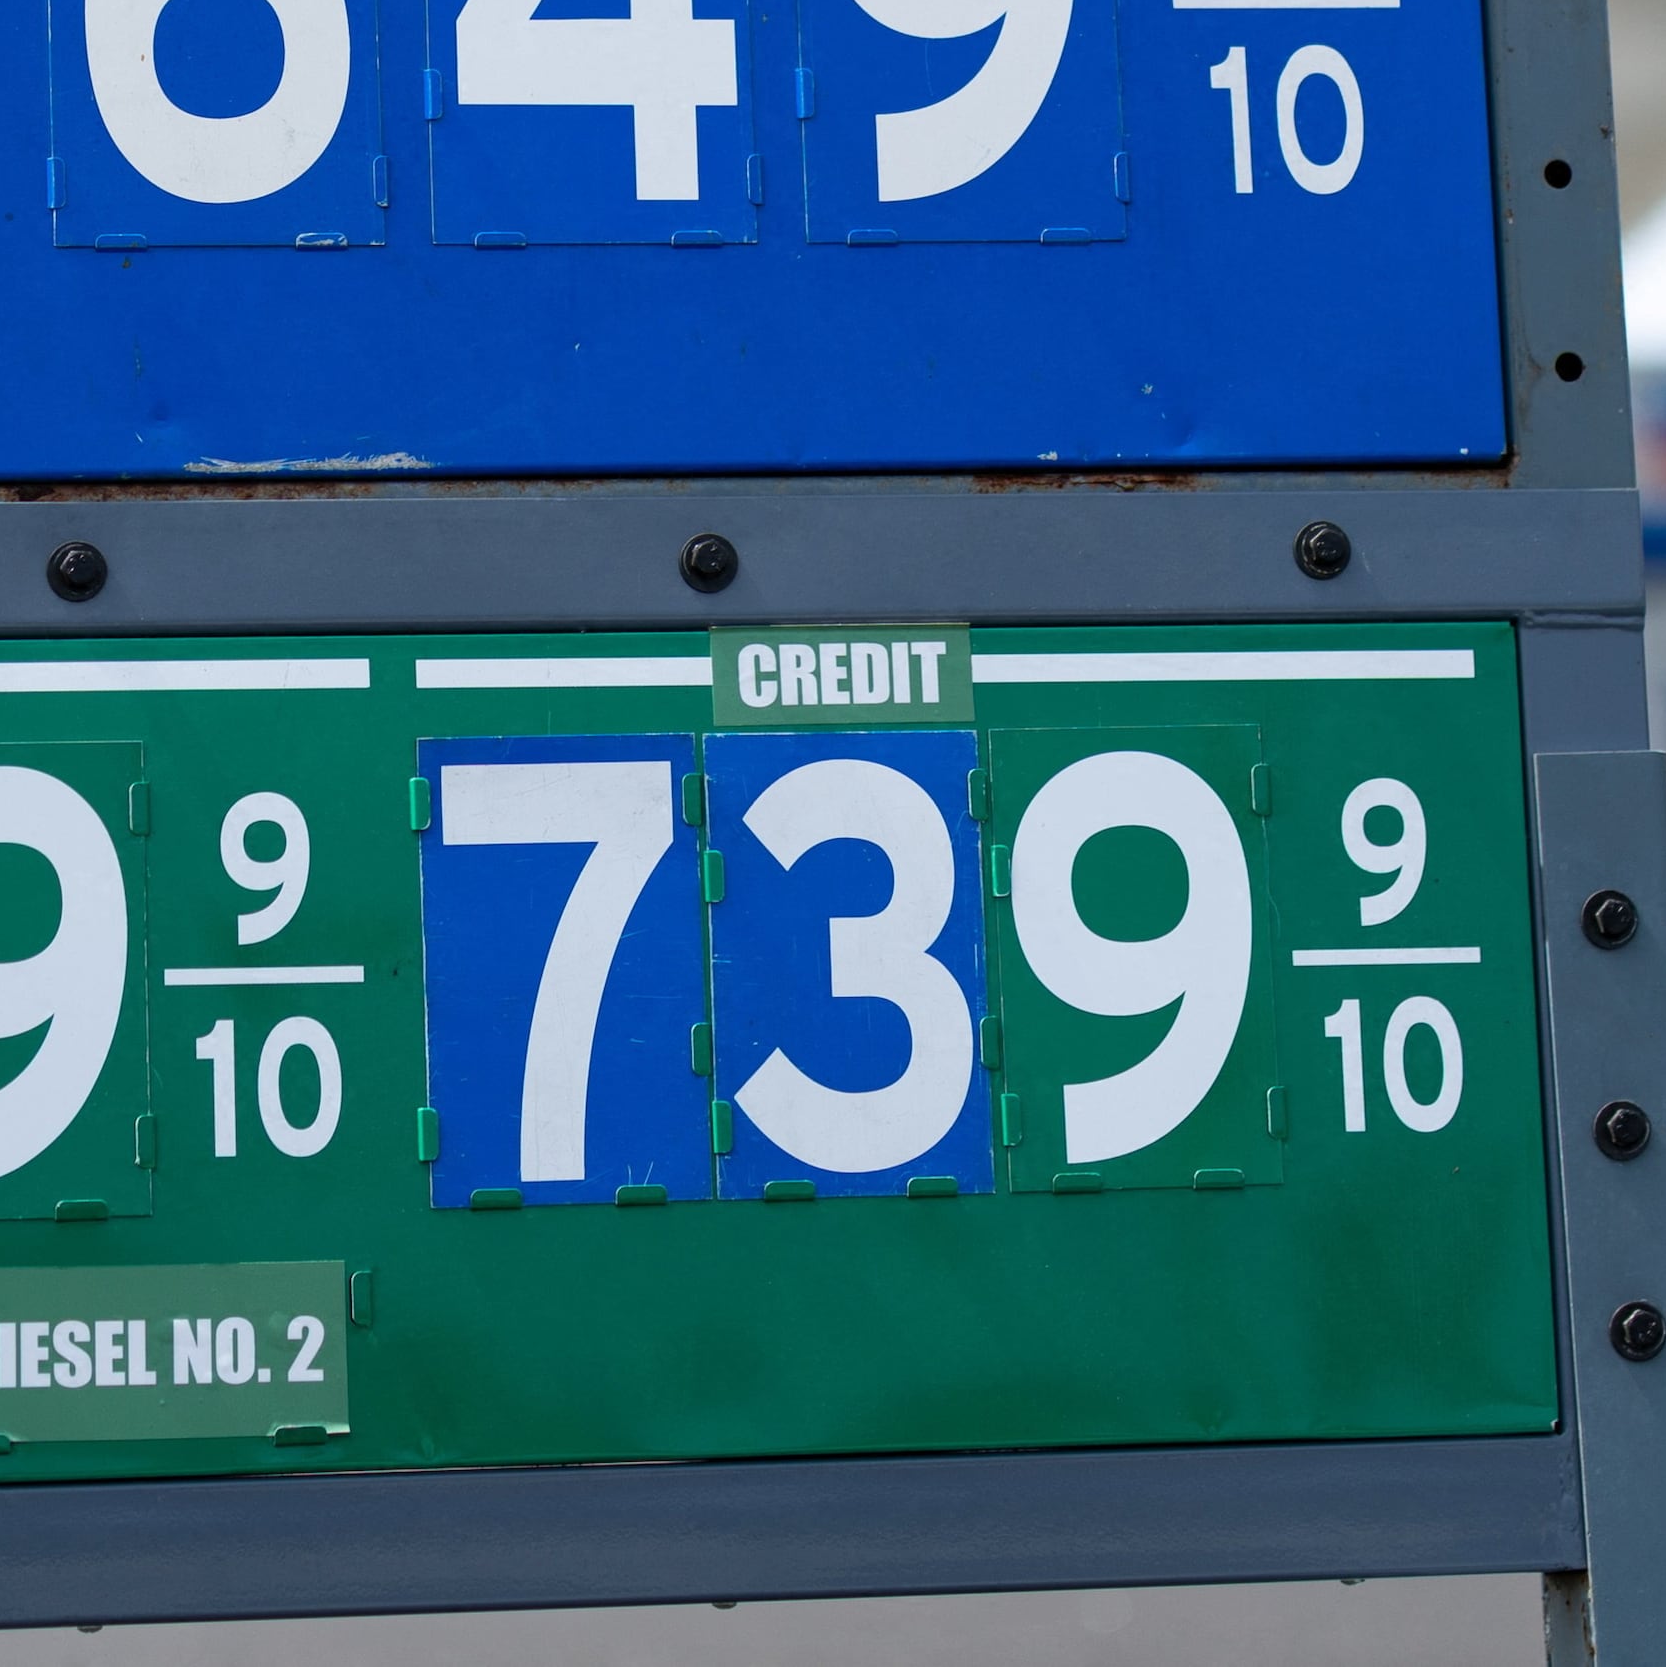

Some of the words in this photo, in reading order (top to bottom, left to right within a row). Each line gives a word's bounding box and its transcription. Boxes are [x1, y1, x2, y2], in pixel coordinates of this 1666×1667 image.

[1209, 44, 1365, 196] 10
[736, 639, 948, 709] CREDIT
[219, 790, 311, 947] 9
[1340, 776, 1428, 928] 9
[440, 750, 1254, 1183] 739
[194, 1015, 344, 1159] 10
[1323, 994, 1465, 1134] 10
[171, 1316, 272, 1386] NO.
[285, 1314, 326, 1384] 2
